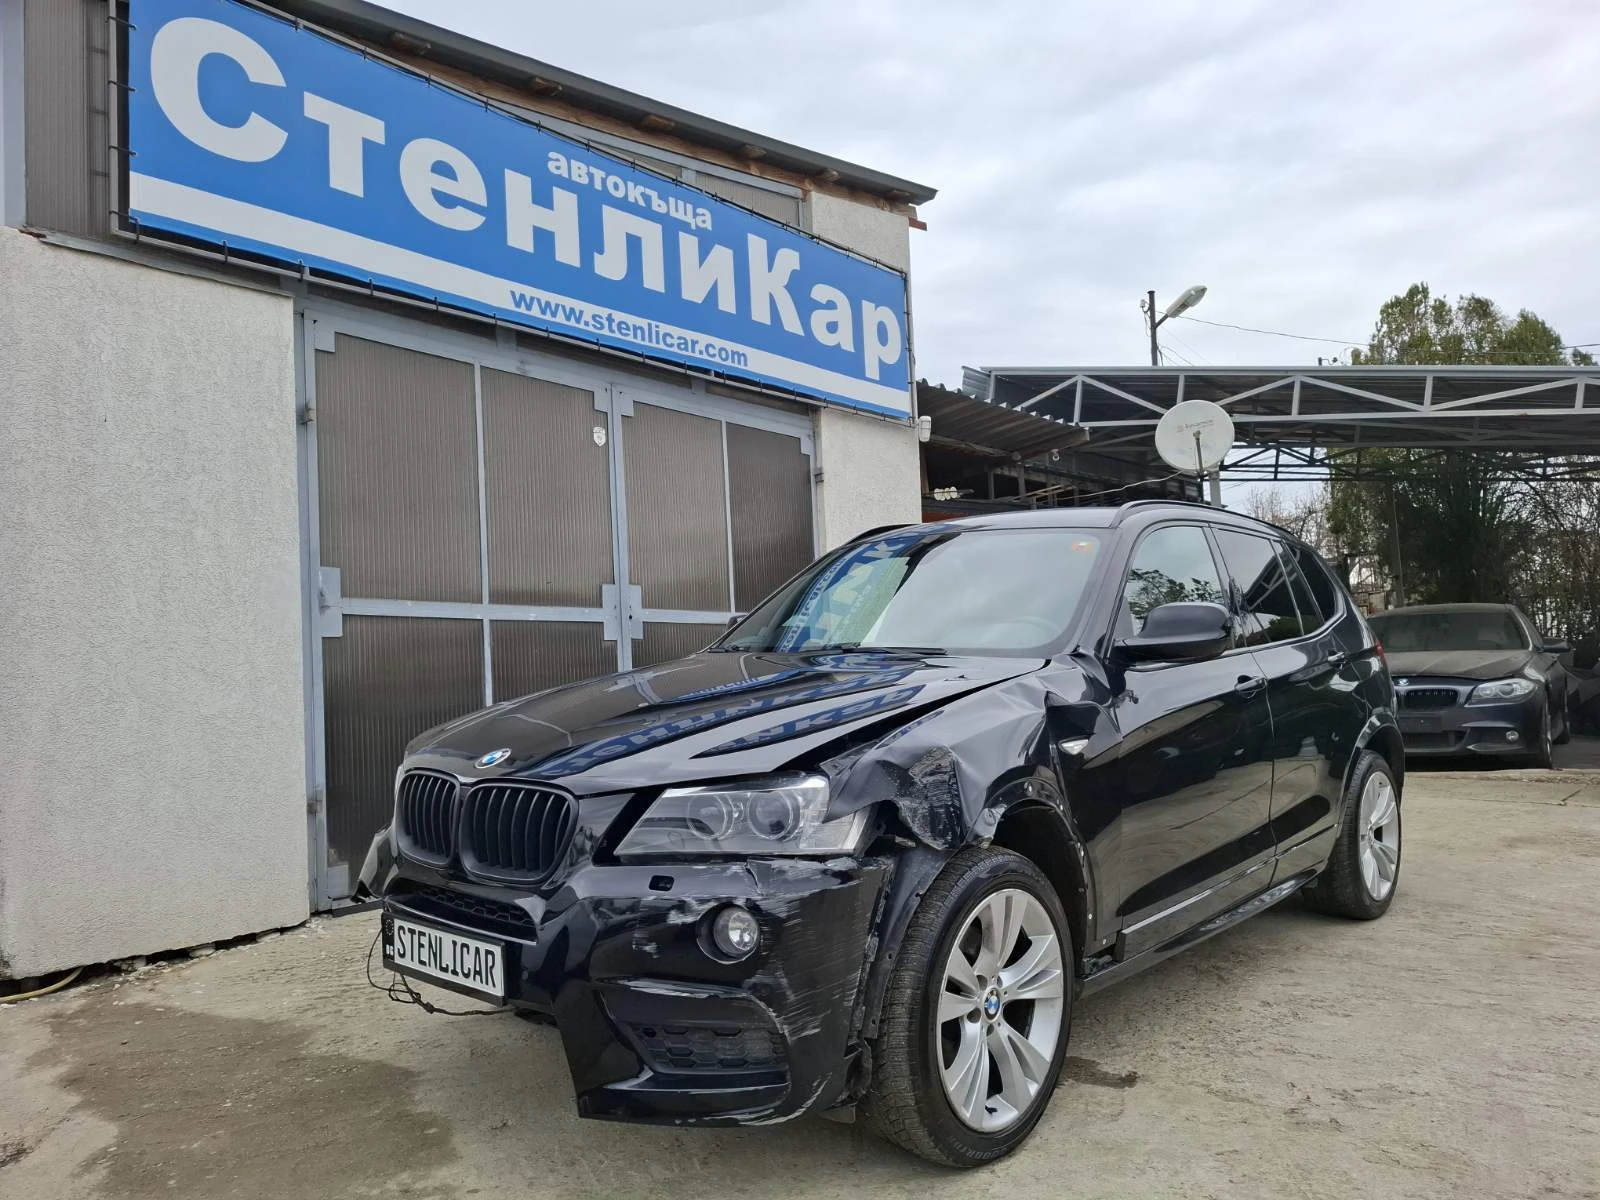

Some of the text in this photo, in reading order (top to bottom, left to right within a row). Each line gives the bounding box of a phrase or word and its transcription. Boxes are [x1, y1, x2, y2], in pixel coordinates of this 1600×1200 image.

[547, 151, 712, 231] автокъща
[510, 290, 748, 368] www.stenlicar.com
[397, 925, 496, 988] STENLICAR
